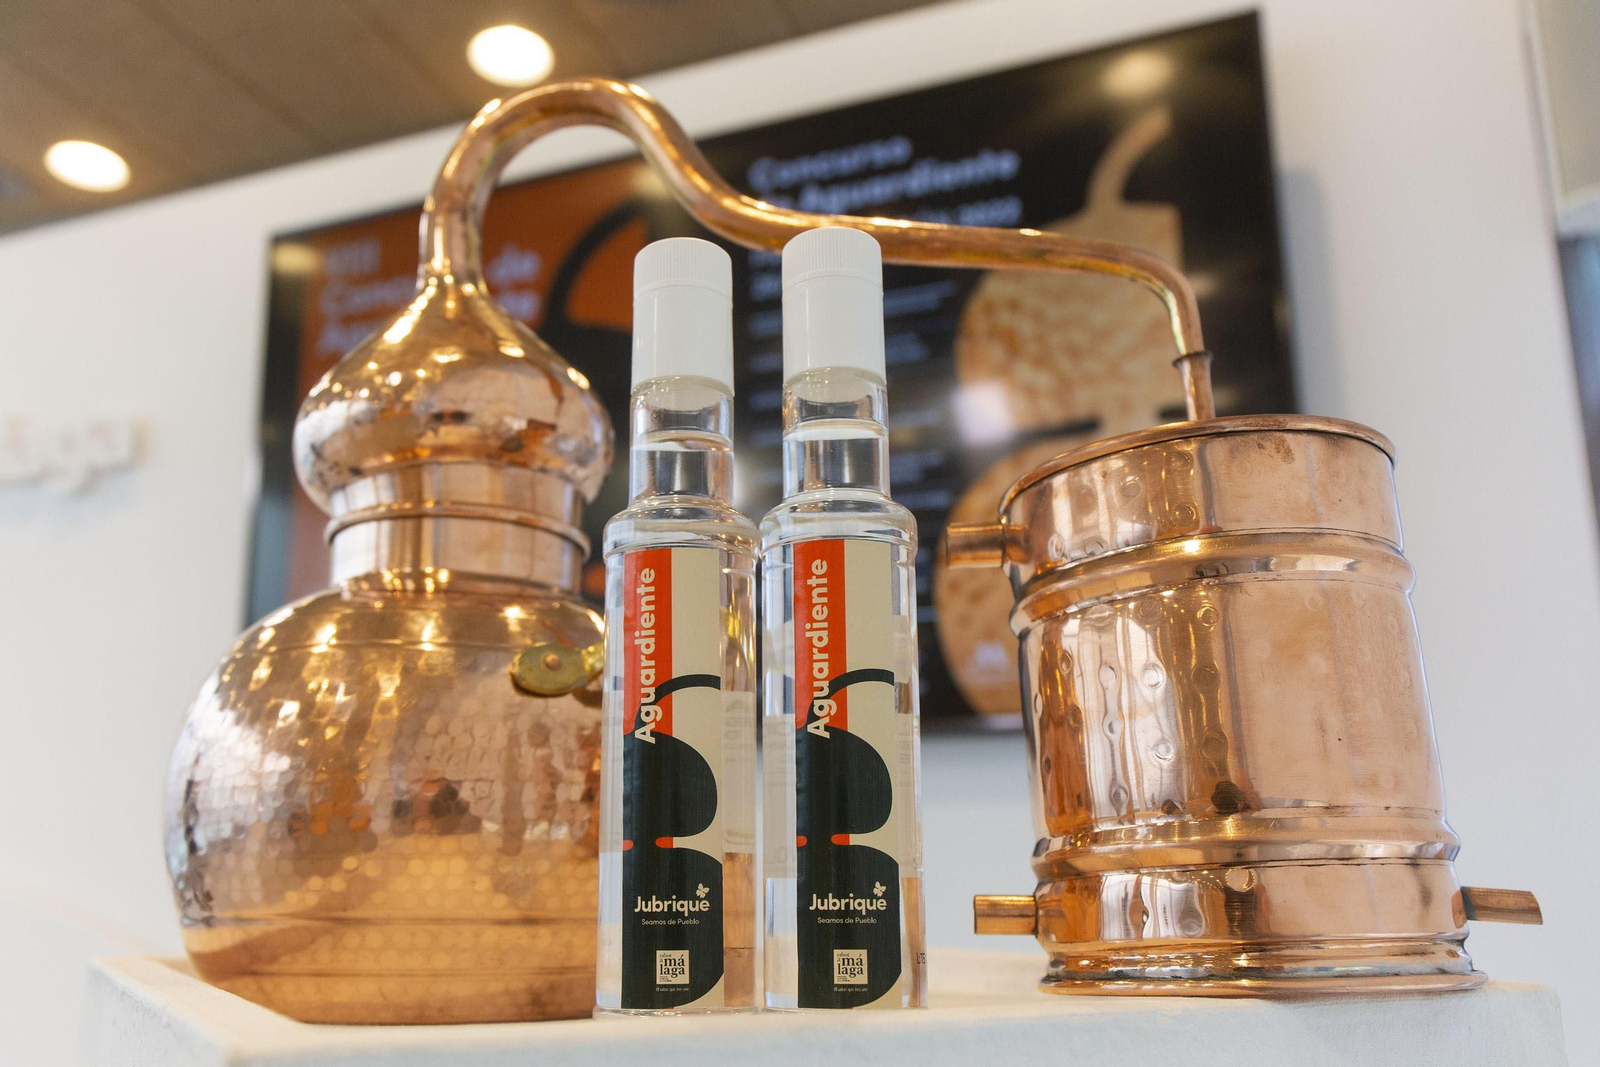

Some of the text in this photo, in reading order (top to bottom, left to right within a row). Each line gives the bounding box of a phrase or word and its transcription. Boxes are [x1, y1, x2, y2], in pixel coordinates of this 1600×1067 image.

[634, 568, 662, 744] Aguardiente
[805, 559, 837, 739] Aguardiente
[634, 895, 710, 917] Jubrique
[809, 893, 887, 915] Jubrique
[664, 954, 685, 966] má
[842, 953, 863, 966] má
[660, 964, 685, 978] laga
[838, 963, 863, 978] laga
